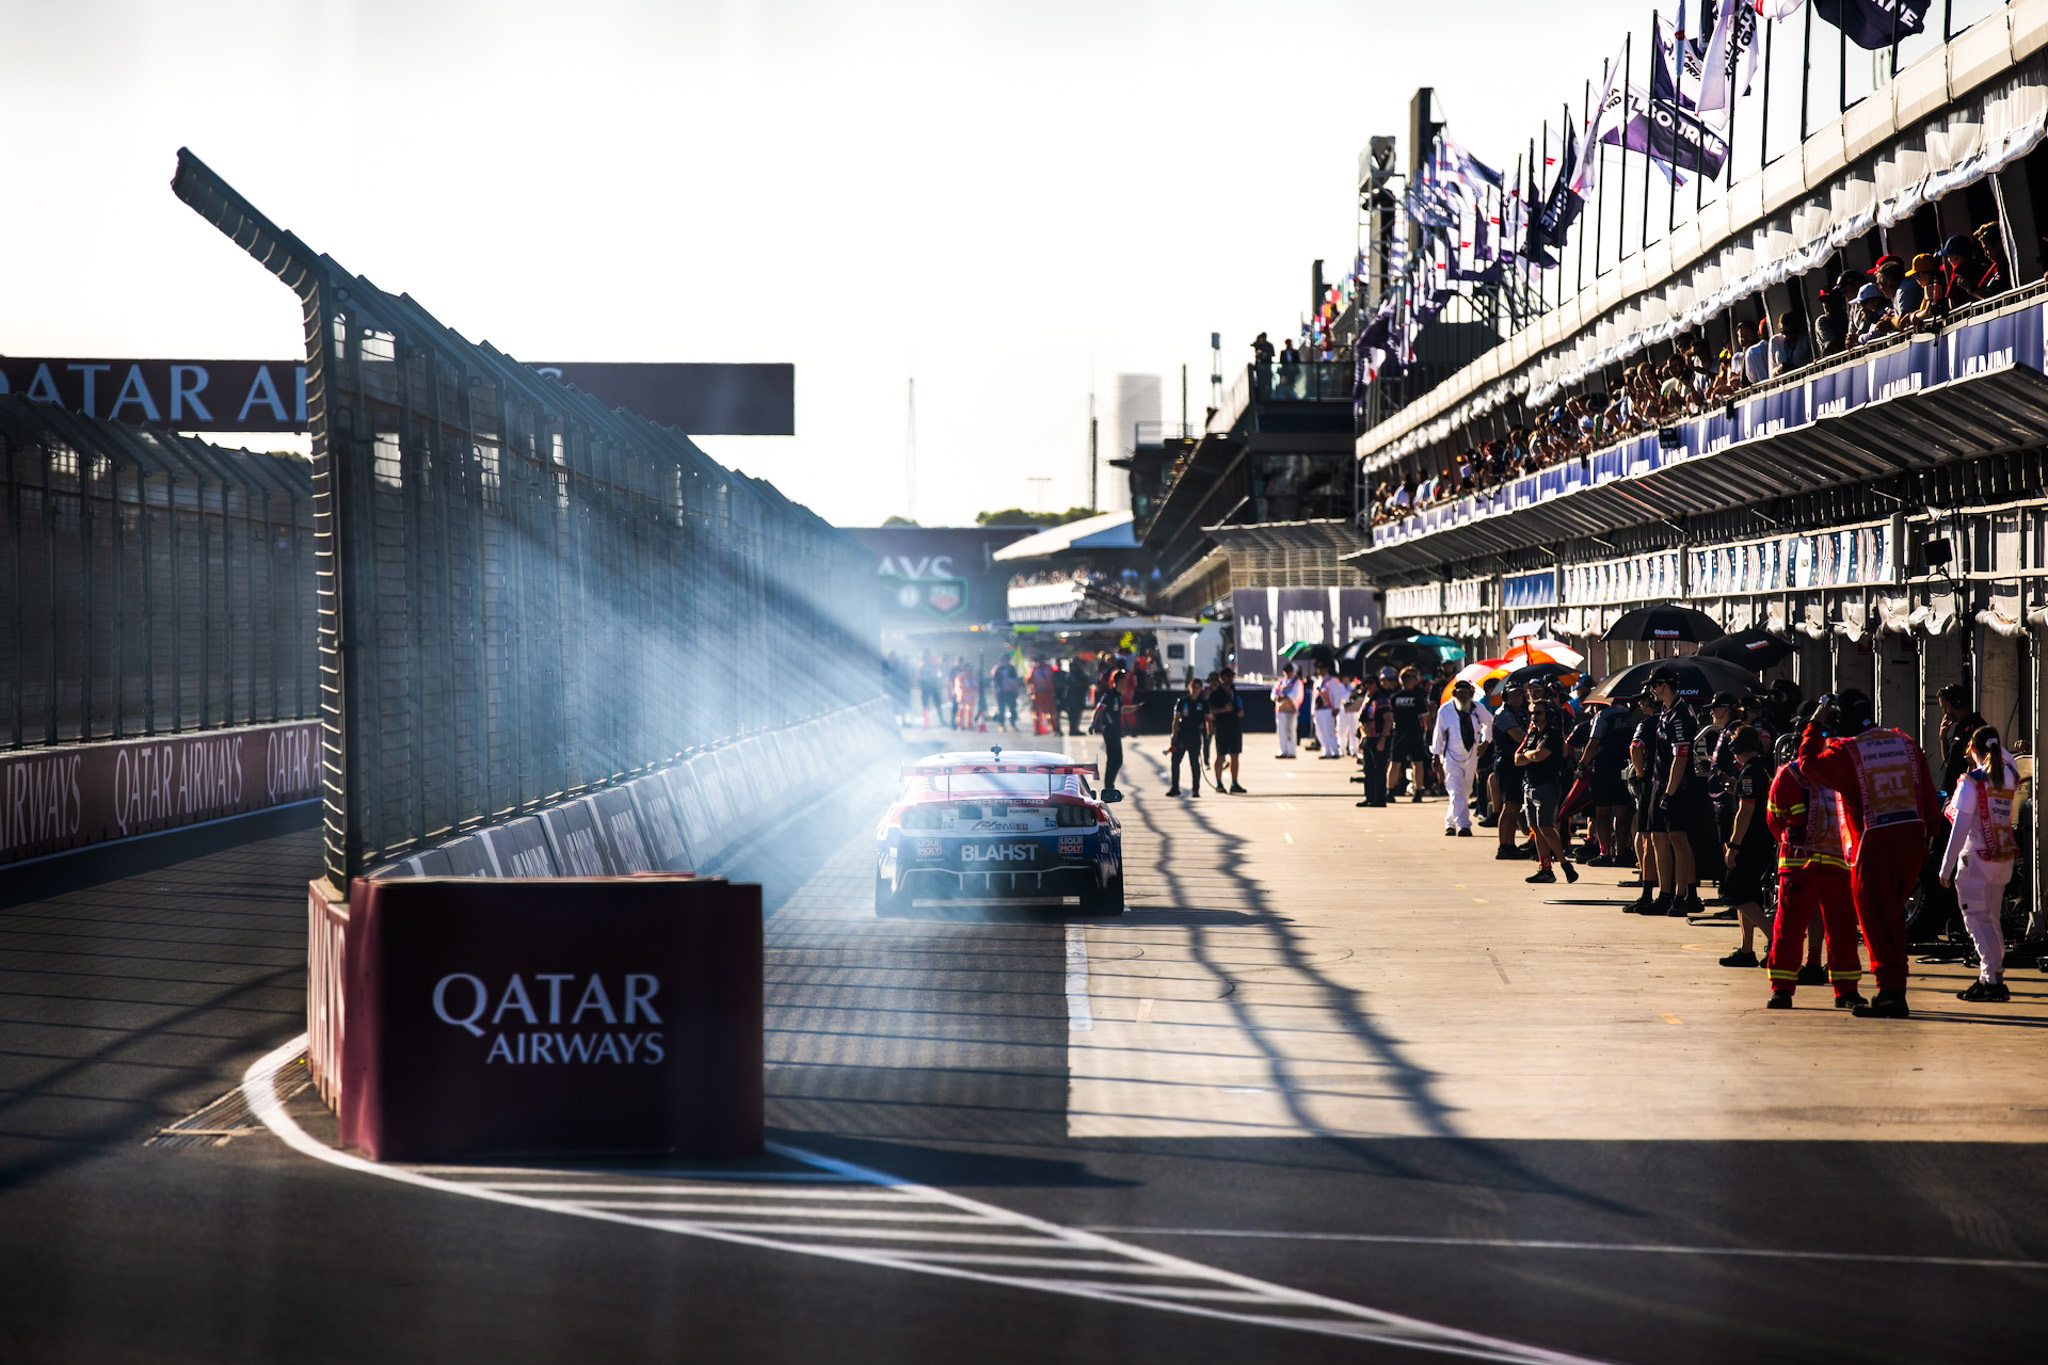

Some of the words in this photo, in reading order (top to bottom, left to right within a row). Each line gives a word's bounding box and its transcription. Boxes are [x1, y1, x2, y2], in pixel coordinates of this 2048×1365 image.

[114, 745, 174, 836] QATAR
[177, 735, 243, 814] AIRWAYS
[266, 727, 310, 804] QATAR
[0, 754, 81, 849] IRWAYS
[961, 844, 1039, 862] BLAHST
[1060, 837, 1082, 845] LIQUI
[1060, 844, 1082, 853] MOLY
[432, 972, 665, 1037] QATAR
[486, 1032, 665, 1065] AIRWAYS
